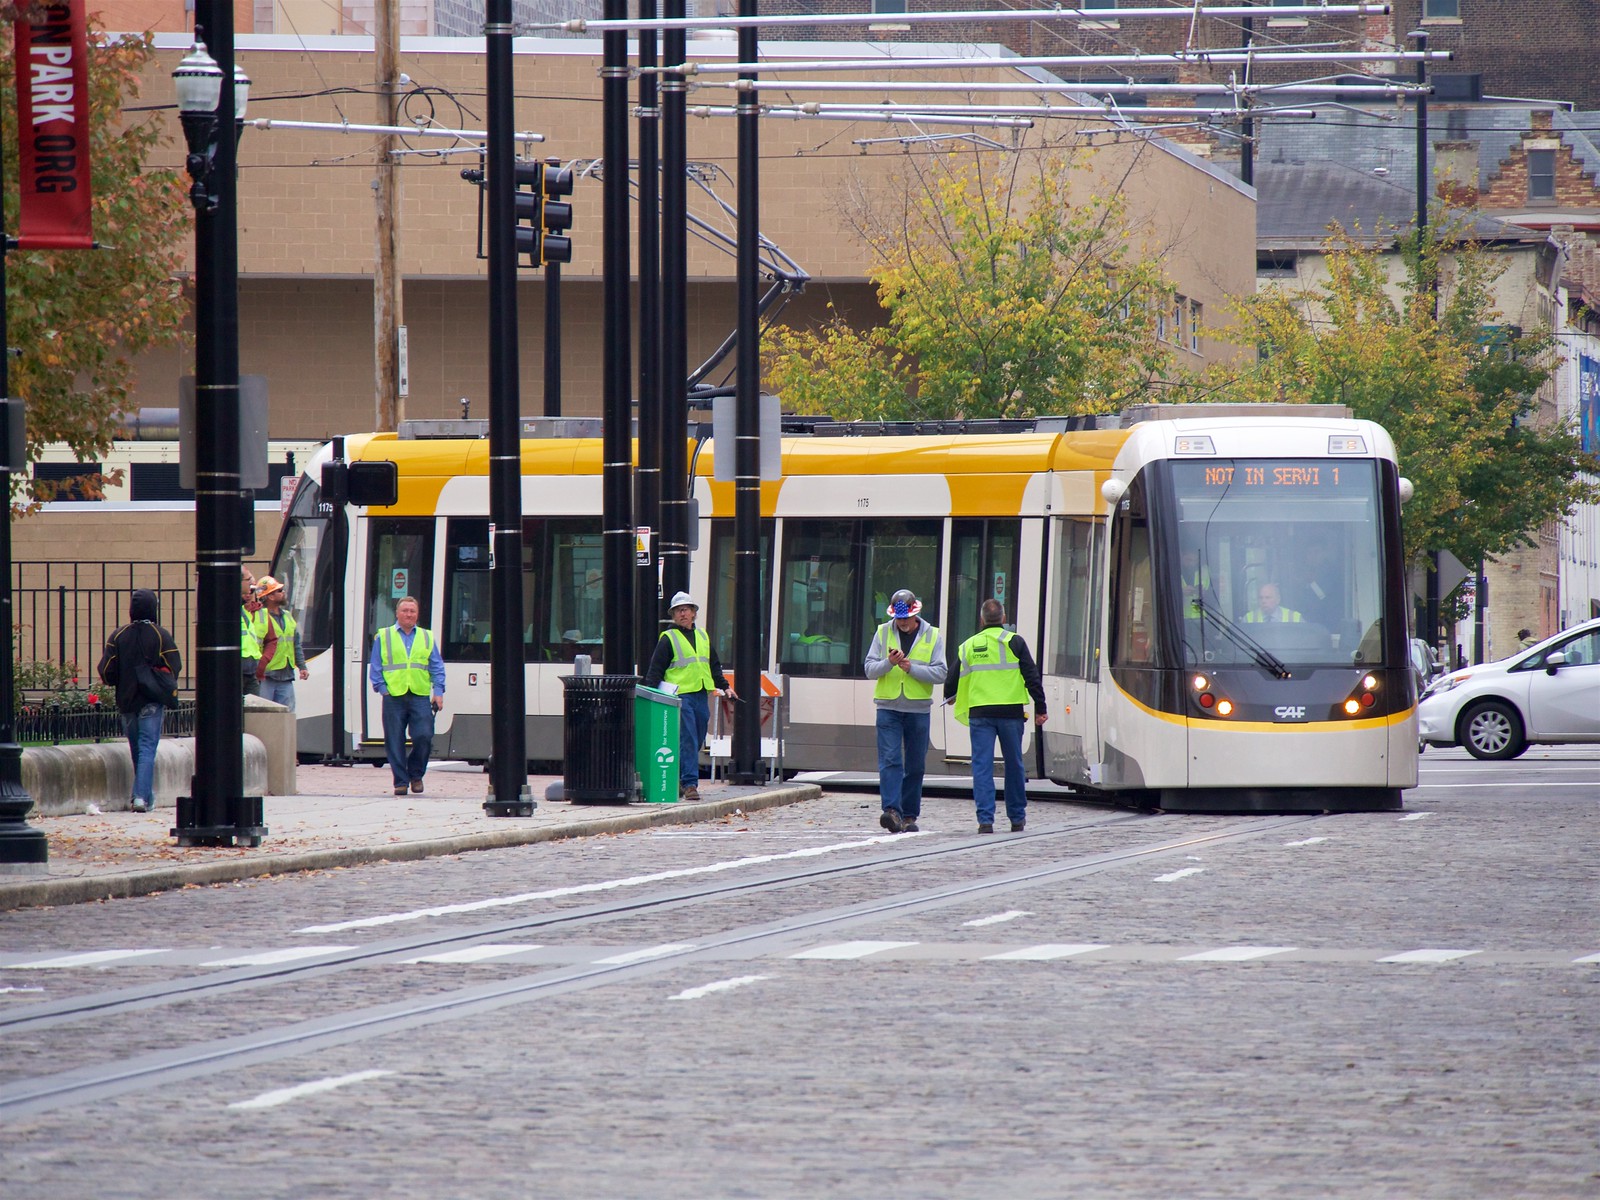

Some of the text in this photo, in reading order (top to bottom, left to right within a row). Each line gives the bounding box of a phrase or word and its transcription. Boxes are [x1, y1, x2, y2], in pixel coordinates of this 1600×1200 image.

[1205, 467, 1235, 485] NOT
[1245, 467, 1265, 485] IN
[1272, 467, 1320, 485] SERVI
[857, 498, 869, 508] 1175
[1274, 706, 1306, 719] CAF
